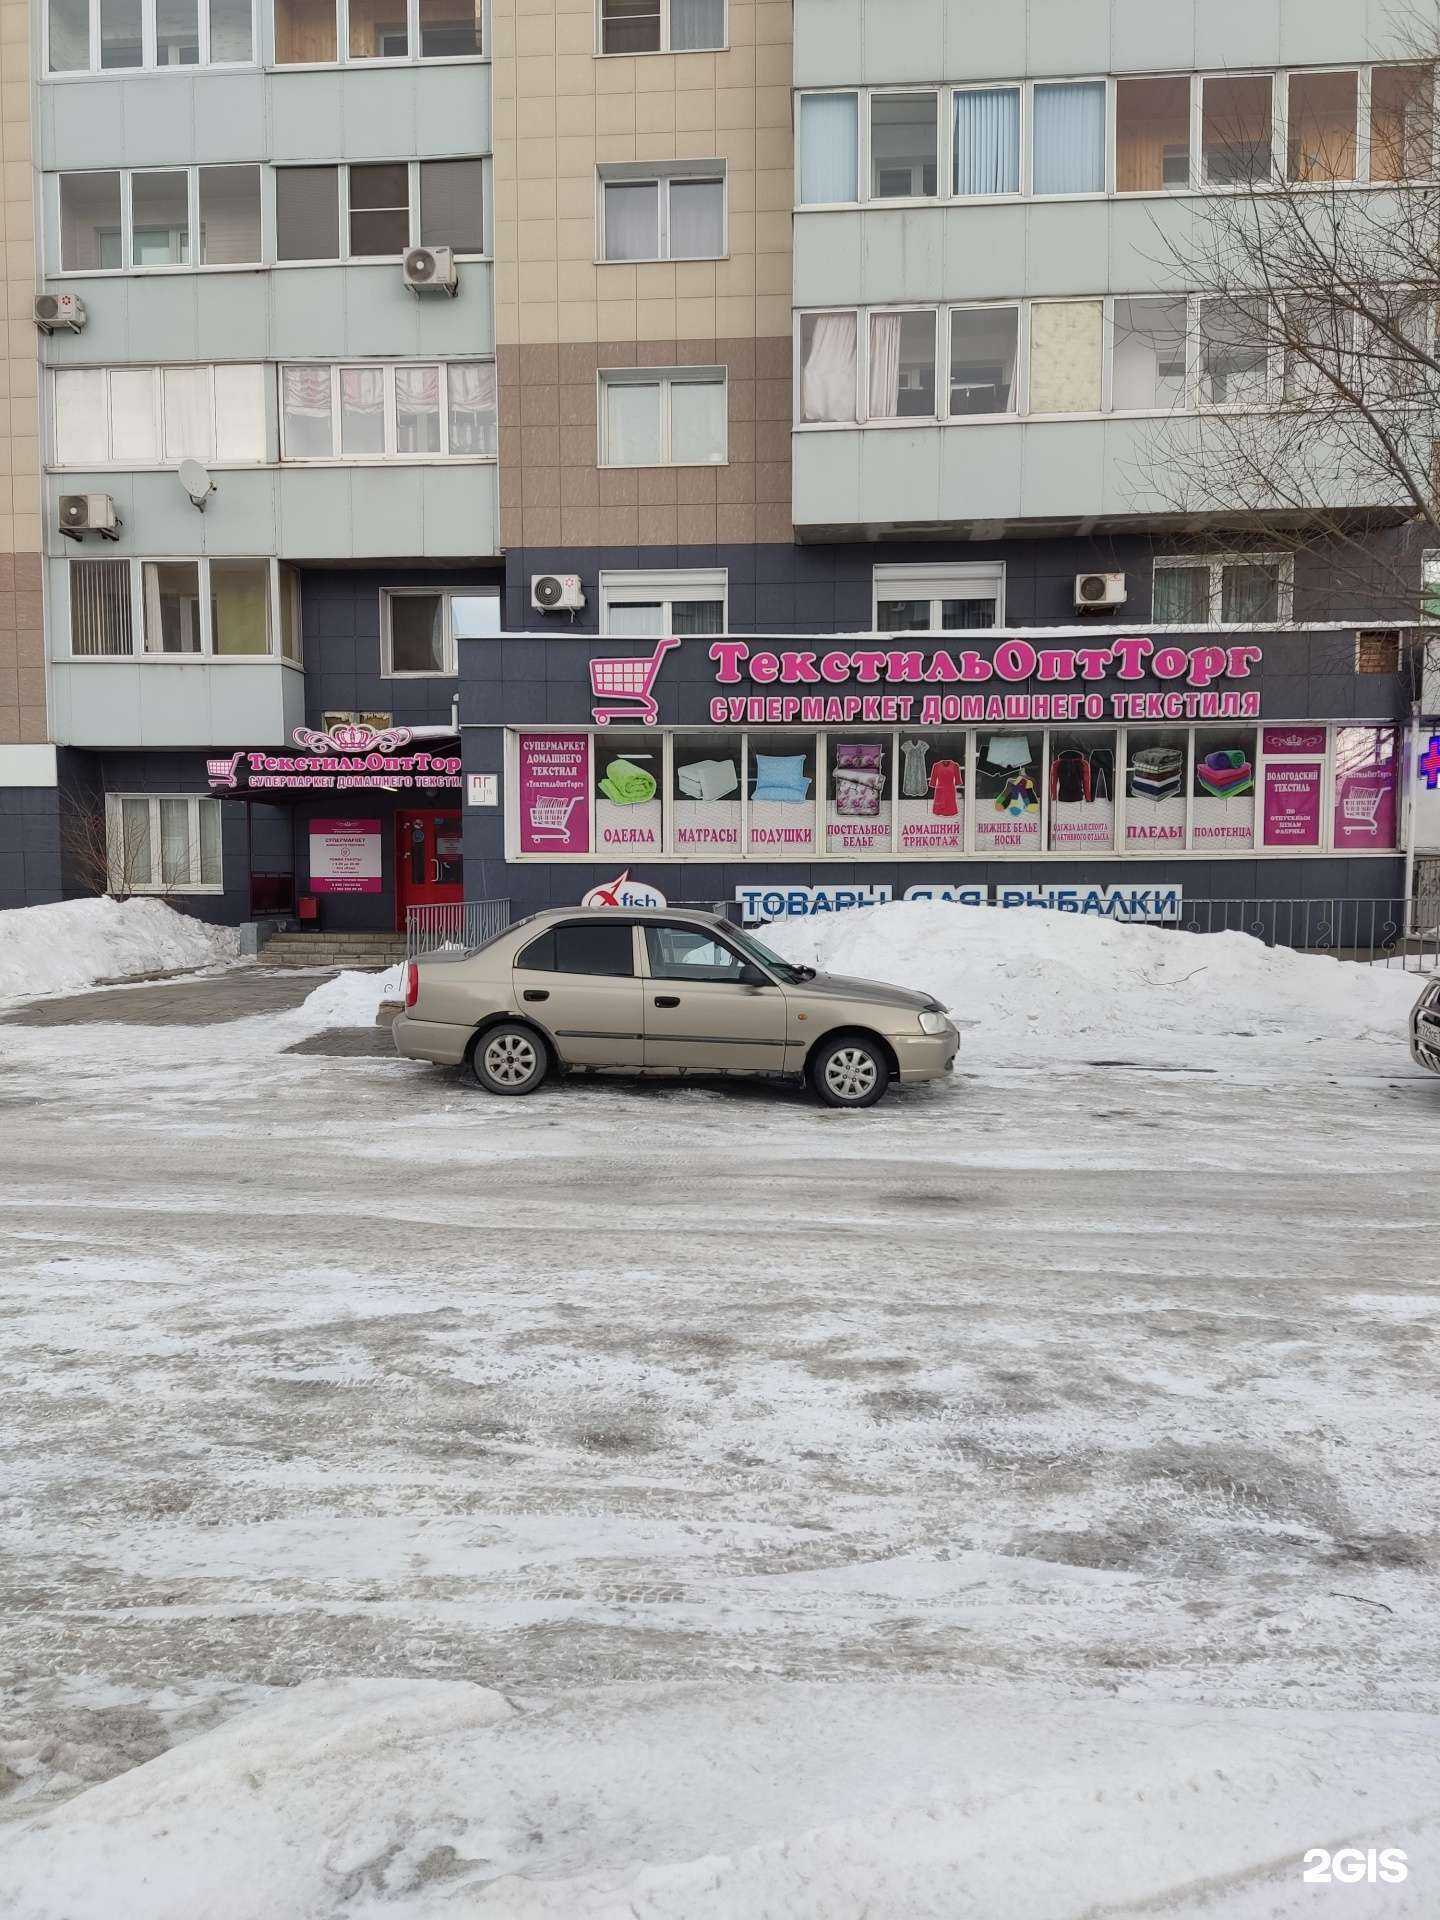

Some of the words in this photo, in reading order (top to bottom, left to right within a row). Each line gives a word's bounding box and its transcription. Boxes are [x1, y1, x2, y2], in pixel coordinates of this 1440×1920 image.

[709, 638, 1262, 686] ТекстильОптТорг
[710, 694, 914, 722] СУПЕРМАРКЕТ
[921, 694, 1104, 725] ДОМАШНЕГО
[1111, 691, 1261, 719] ТЕКСТИЛЯ
[523, 741, 586, 751] СУПЕРМАРКЕТ
[248, 753, 462, 774] ТекстильОптТор
[527, 754, 582, 764] ДОМАШНЕГО
[532, 766, 577, 776] ТЕКСТИЛЯ
[1267, 770, 1318, 780] ВОЛОГОДСКИЙ
[248, 775, 335, 788] СУПЕРМАРКЕТ
[337, 775, 412, 789] ДОМАШНЕГО
[415, 775, 463, 788] ТЕКСТИ
[473, 776, 491, 788] ПГ
[1274, 783, 1311, 792] ТЕКСТИЛЬ
[827, 824, 890, 835] ПОСТЕЛЬНОЕ
[902, 822, 960, 835] ДОМАШНИЙ
[978, 823, 1012, 833] НИЖНЕЕ
[1013, 823, 1038, 833] БЕЛЬЕ
[1127, 826, 1183, 840] ПЛЕДЫ
[1194, 826, 1252, 838] ПОЛОТЕНЦА
[604, 828, 655, 844] ОДЕЯЛА
[678, 828, 737, 843] МАТРАСЫ
[751, 828, 812, 844] ПОДУШКИ
[903, 836, 959, 847] ТРИКОТАЖ
[994, 835, 1021, 846] НОСКИ
[843, 837, 874, 847] БЕЛЬЕ
[742, 891, 886, 915] ТОВАРЫ
[1003, 890, 1176, 914] РЫБАЛКИ
